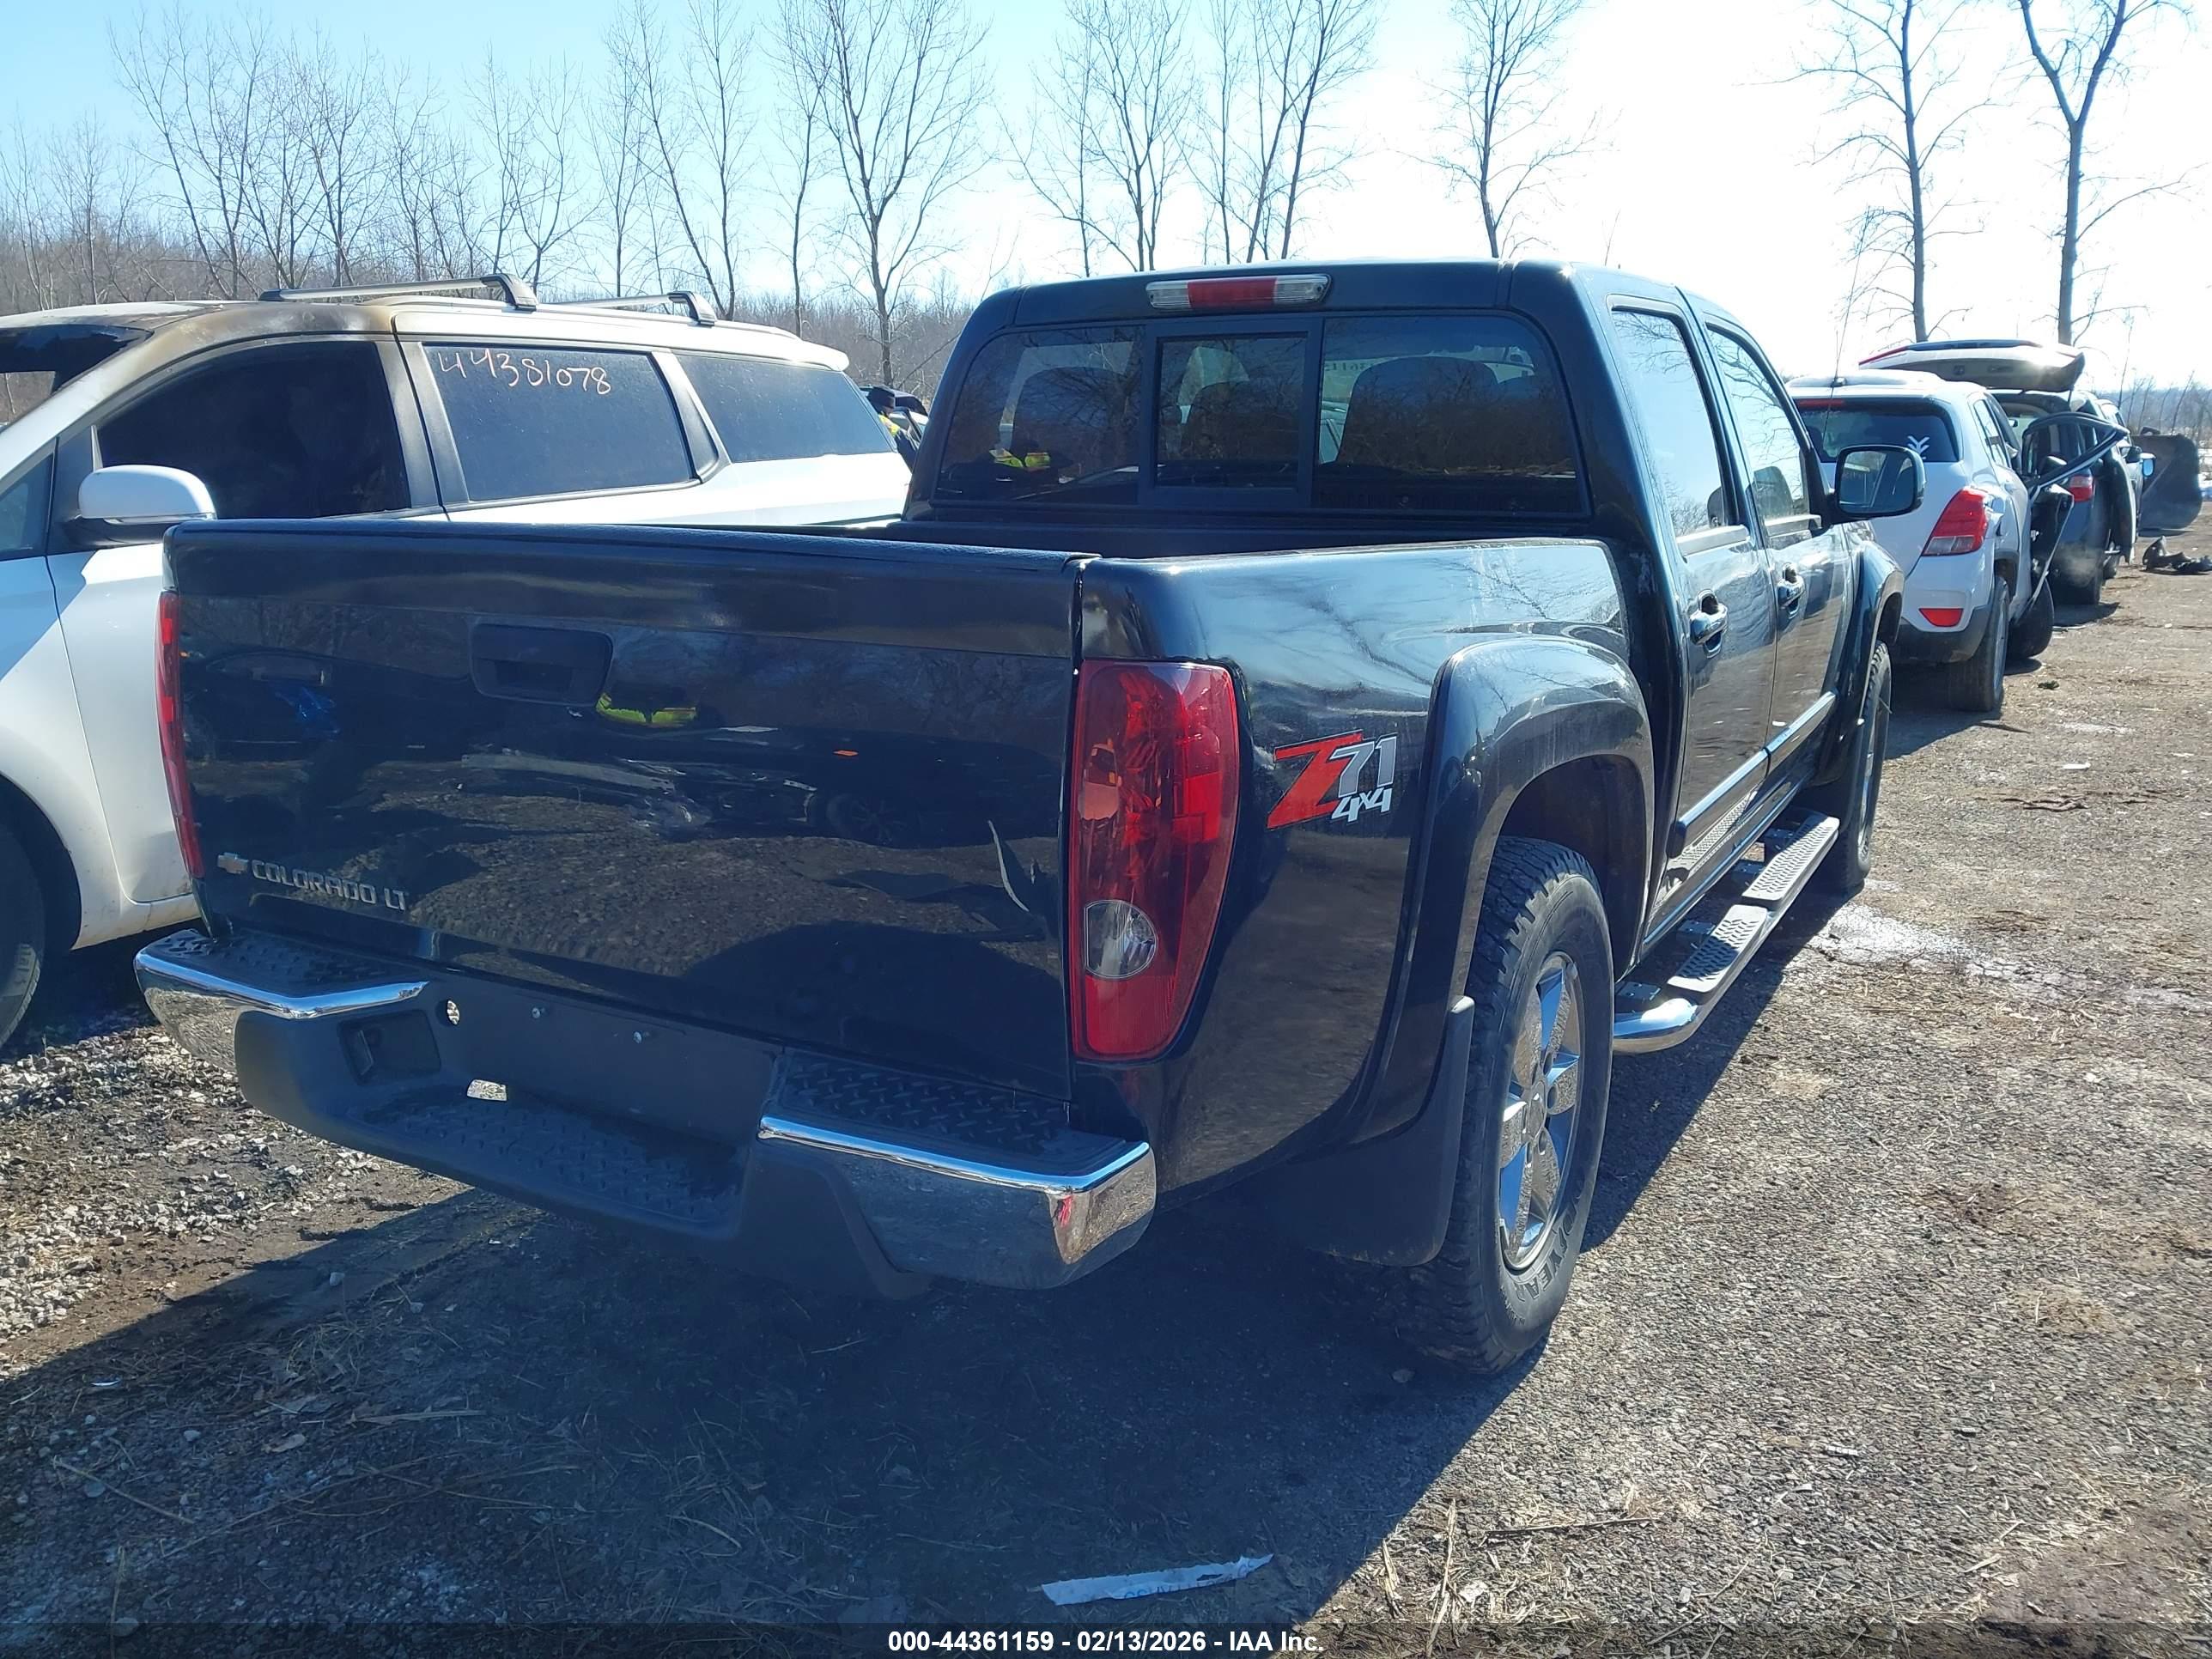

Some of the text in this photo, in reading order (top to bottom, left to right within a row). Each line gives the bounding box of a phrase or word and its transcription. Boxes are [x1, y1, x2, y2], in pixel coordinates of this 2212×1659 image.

[437, 348, 611, 395] 44381078
[1267, 730, 1397, 830] Z71
[252, 860, 405, 910] COLORADO LT
